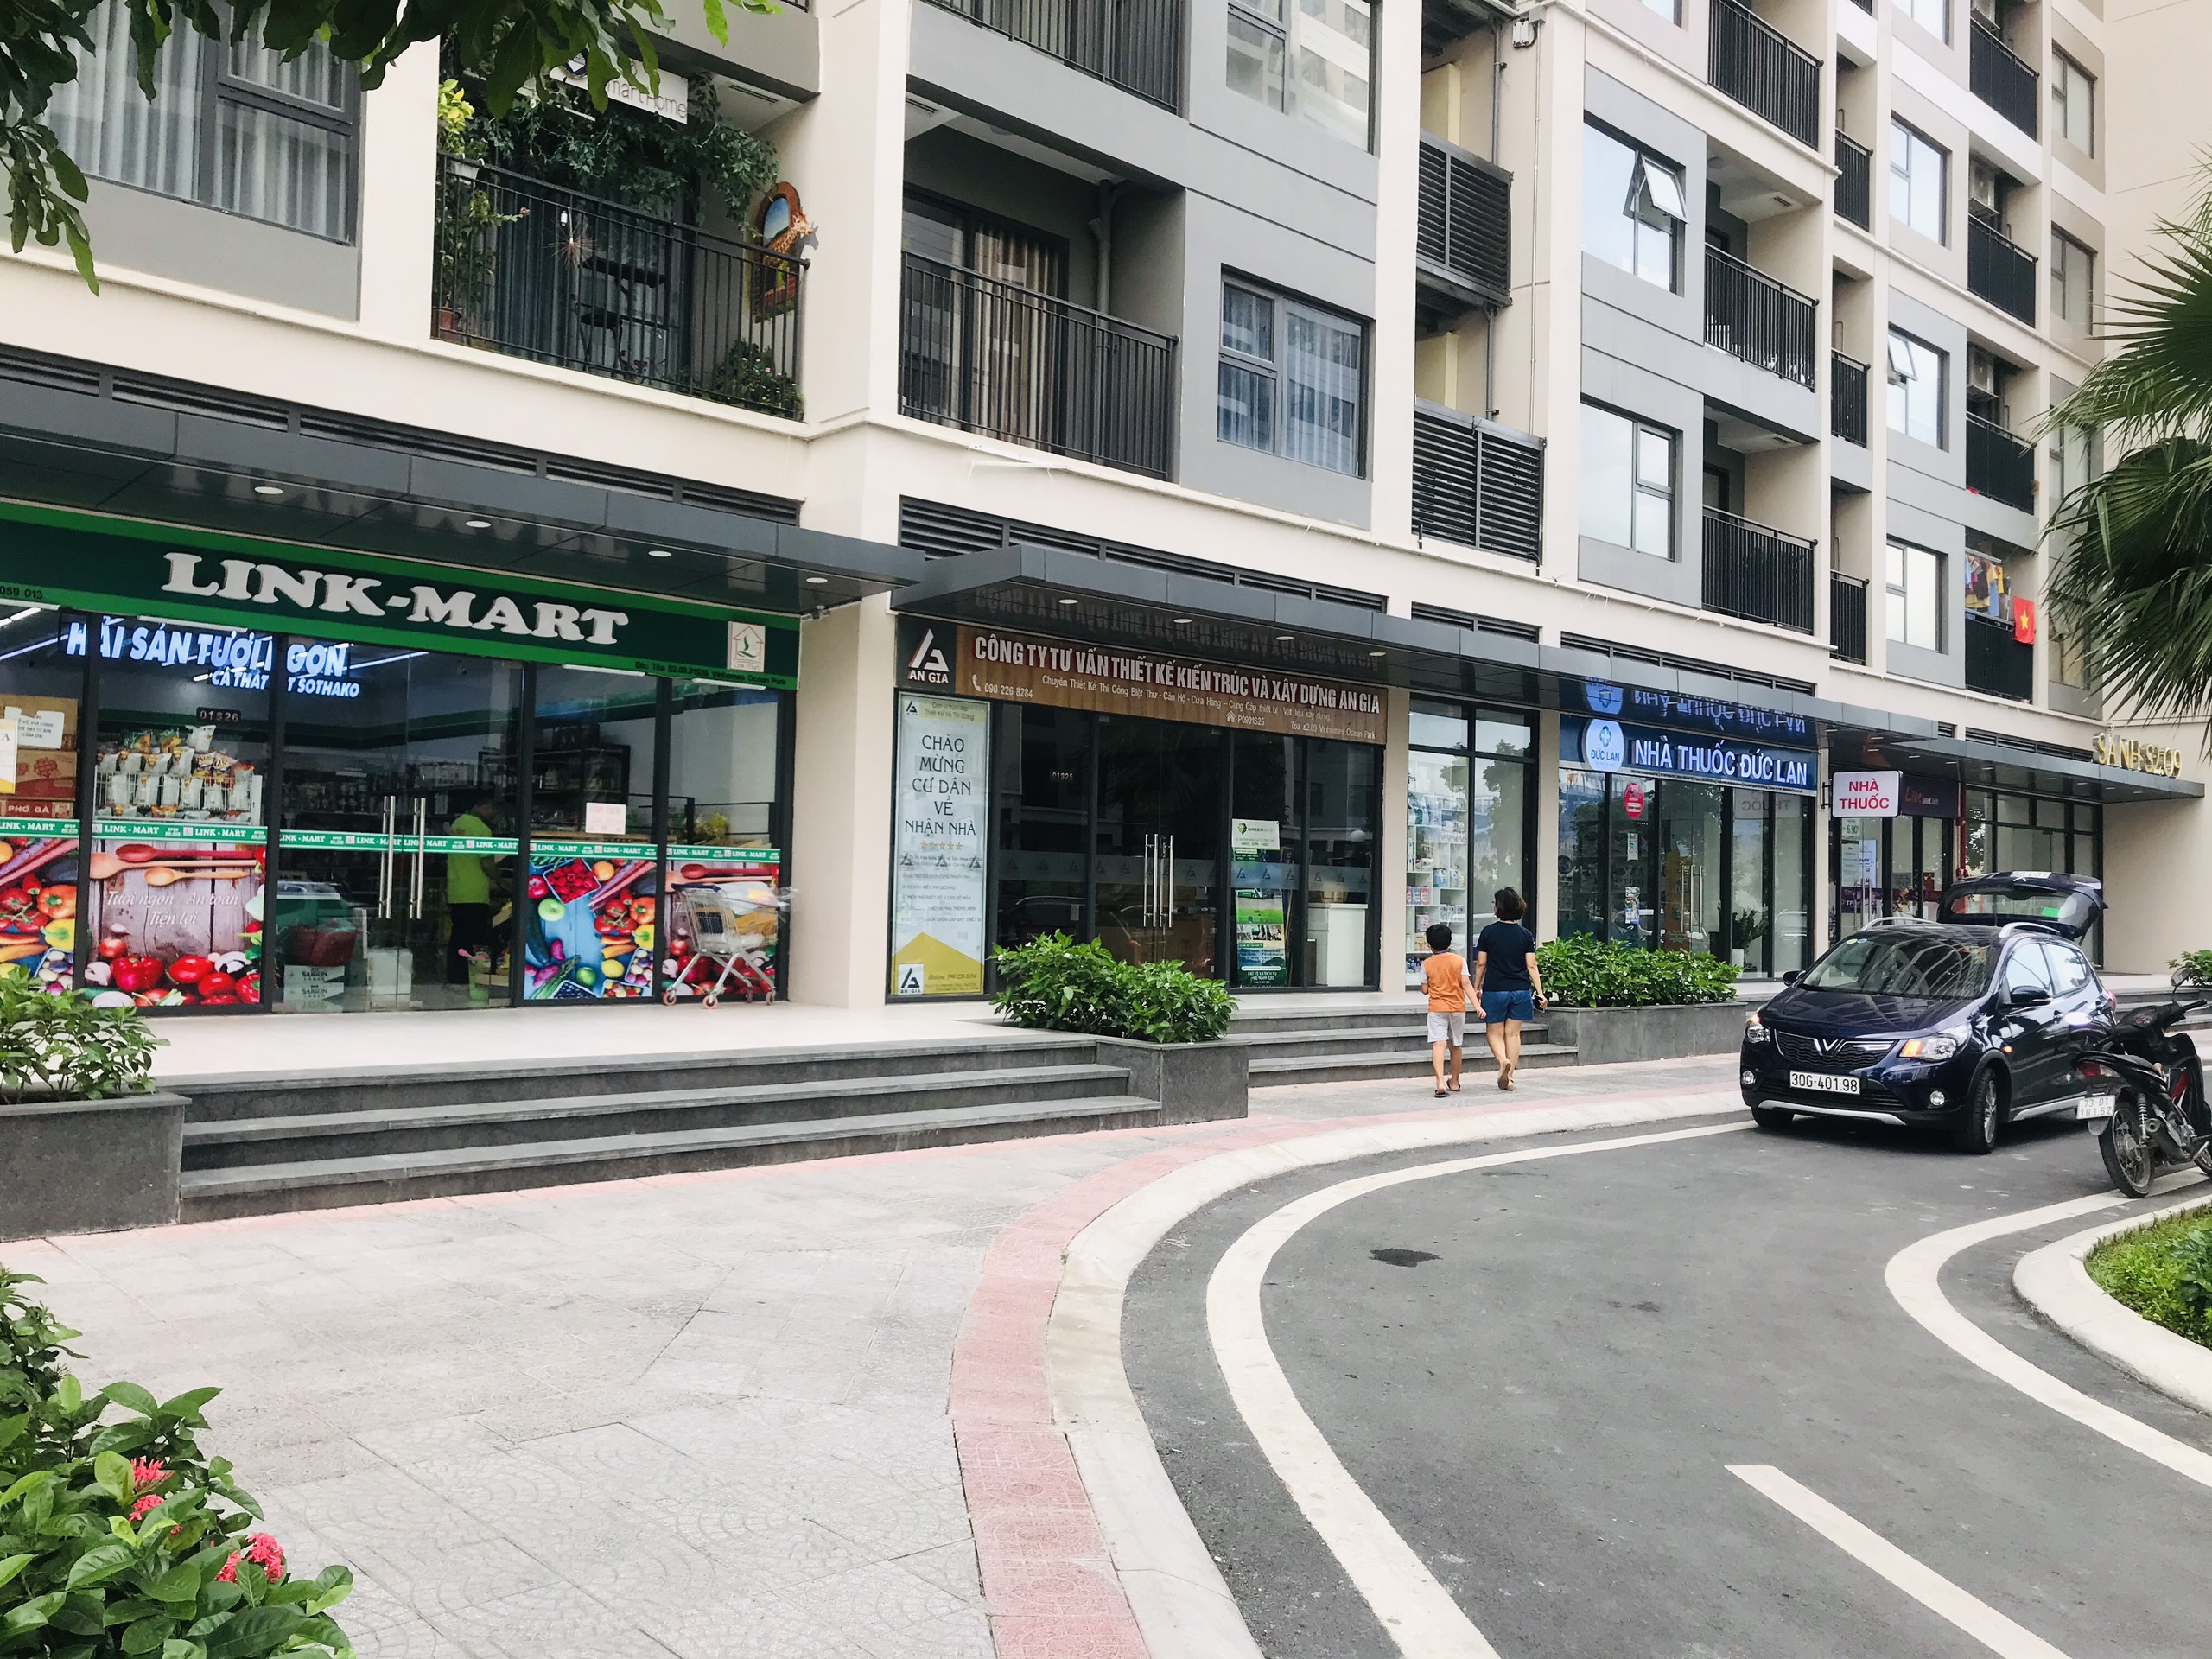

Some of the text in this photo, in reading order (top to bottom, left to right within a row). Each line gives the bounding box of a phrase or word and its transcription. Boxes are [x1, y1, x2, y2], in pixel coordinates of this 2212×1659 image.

[160, 551, 630, 645] LINK-MART
[908, 671, 949, 684] AN GIA
[975, 634, 1380, 714] CÔNG TY TƯ VẤN THIẾT KẾ KIẾN TRÚC VÀ XÂY DỰNG AN GIA
[297, 678, 360, 698] SOTHAKO
[984, 683, 1033, 698] 090 226 8284
[1099, 683, 1109, 693] Thi
[921, 734, 964, 753] CHÀO
[1363, 730, 1376, 740] Park
[1591, 747, 1620, 761] ĐỨC LAN
[1635, 735, 1808, 785] NHÀ THUỐC ĐỨC LAN
[919, 753, 965, 774] MỪNG
[912, 776, 971, 796] CƯ DÂN
[1848, 778, 1880, 792] NHÀ
[933, 796, 954, 816] VỀ
[1839, 792, 1890, 810] THUỐC
[0, 822, 21, 830] INK
[27, 823, 56, 831] MART
[104, 824, 127, 833] LINK
[132, 826, 160, 835] MART
[194, 828, 216, 836] LINK
[905, 818, 976, 836] NHẬN NHÀ
[302, 835, 326, 843] MART
[356, 836, 375, 845] LINK
[1790, 1072, 1858, 1093] 30G-401.98
[2080, 1106, 2113, 1117] 181.62
